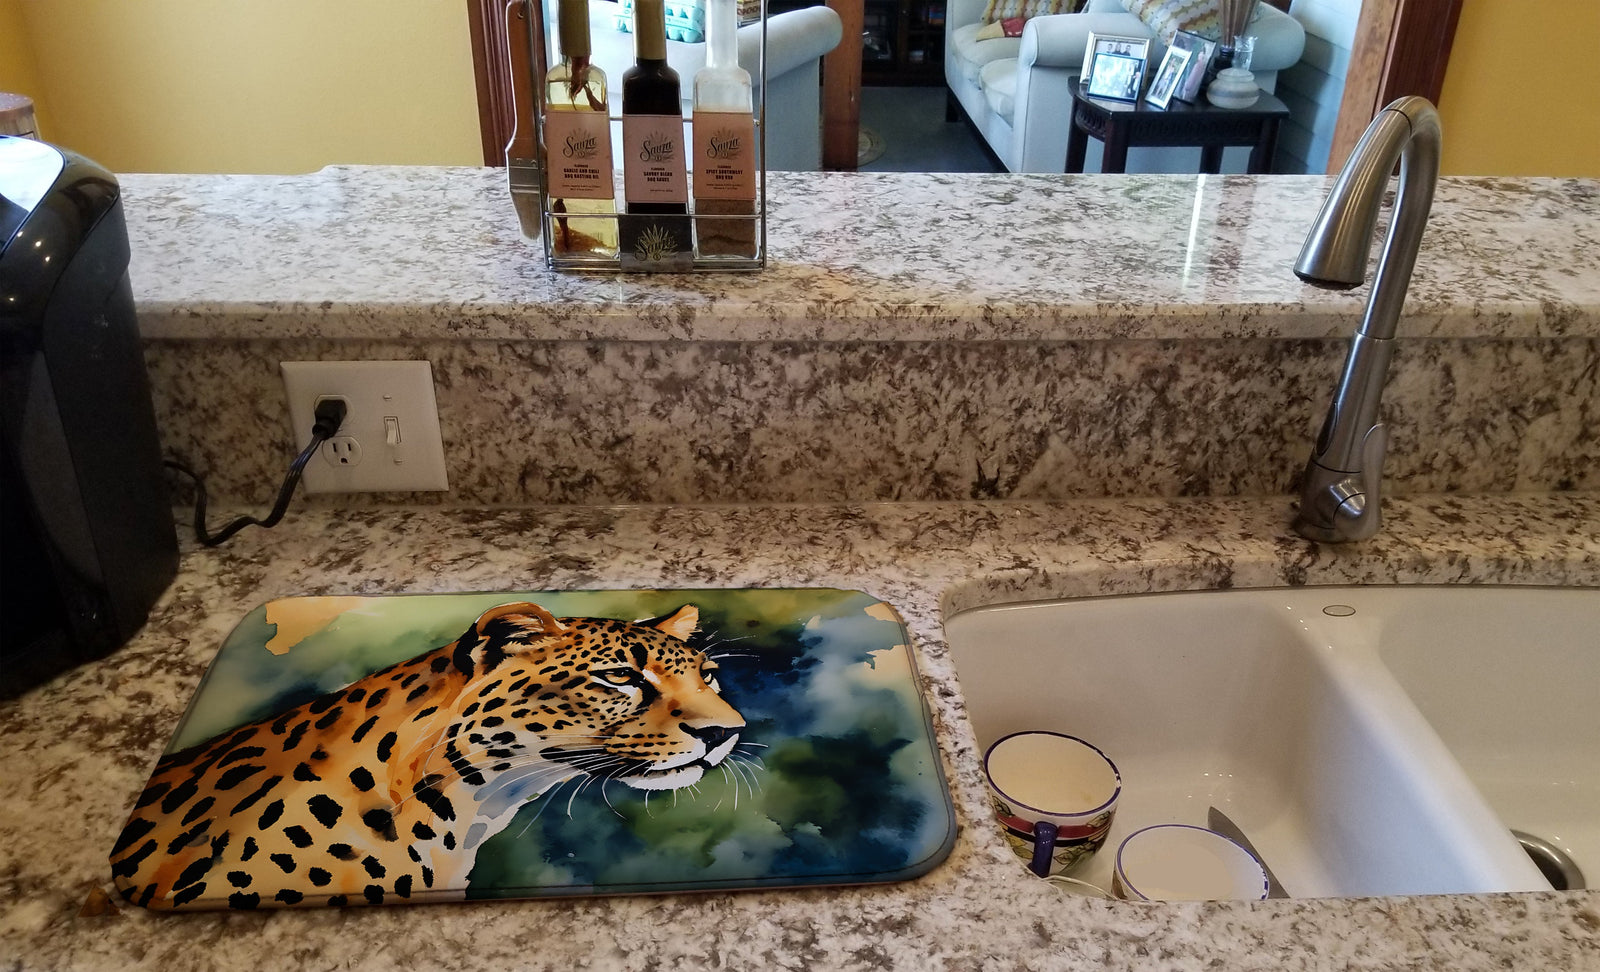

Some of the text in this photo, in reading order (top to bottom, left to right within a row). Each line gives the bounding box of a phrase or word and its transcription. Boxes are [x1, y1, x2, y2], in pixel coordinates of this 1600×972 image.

[563, 136, 597, 158] Sauza
[640, 139, 673, 162] Sauza
[707, 136, 740, 159] Sauza
